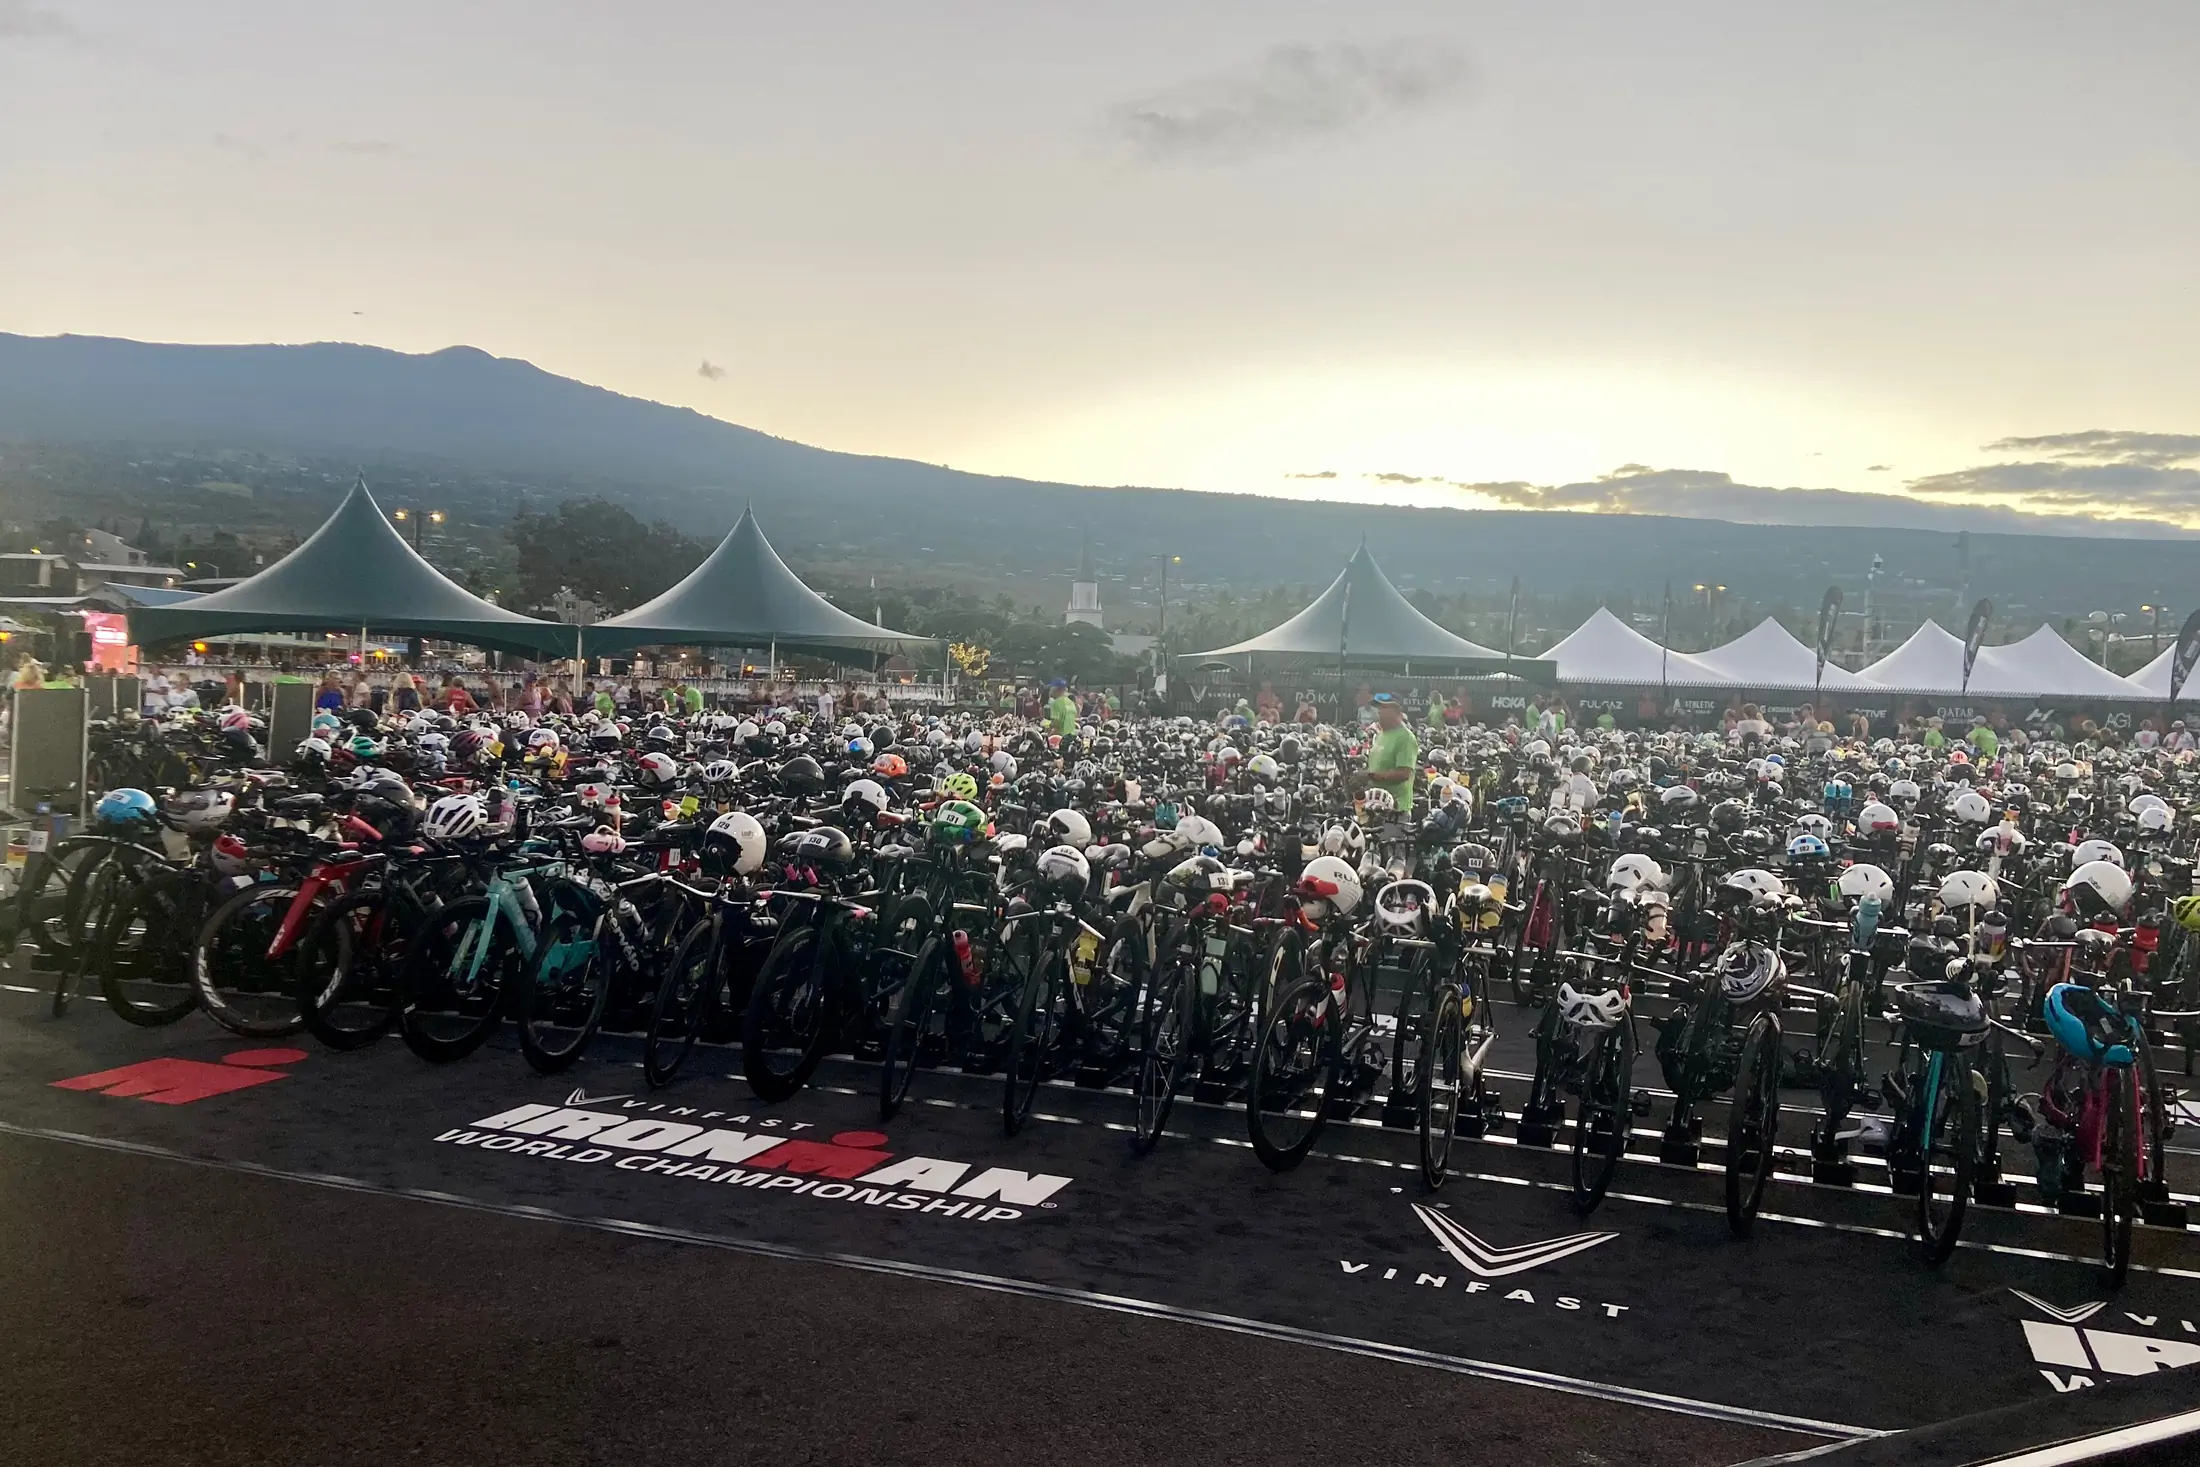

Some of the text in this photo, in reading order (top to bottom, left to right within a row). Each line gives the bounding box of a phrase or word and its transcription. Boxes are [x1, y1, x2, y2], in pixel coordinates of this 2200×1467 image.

[1491, 696, 1526, 709] HOKA
[1937, 707, 1974, 718] QATAR
[717, 821, 731, 830] 129
[946, 814, 959, 824] 131
[809, 836, 822, 845] 130
[622, 1099, 814, 1131] VINFAST
[468, 1103, 1074, 1207] IRONMAN
[432, 1128, 1023, 1222] WORLD CHAMPIONSHIP
[1340, 1260, 1630, 1318] VINFAST
